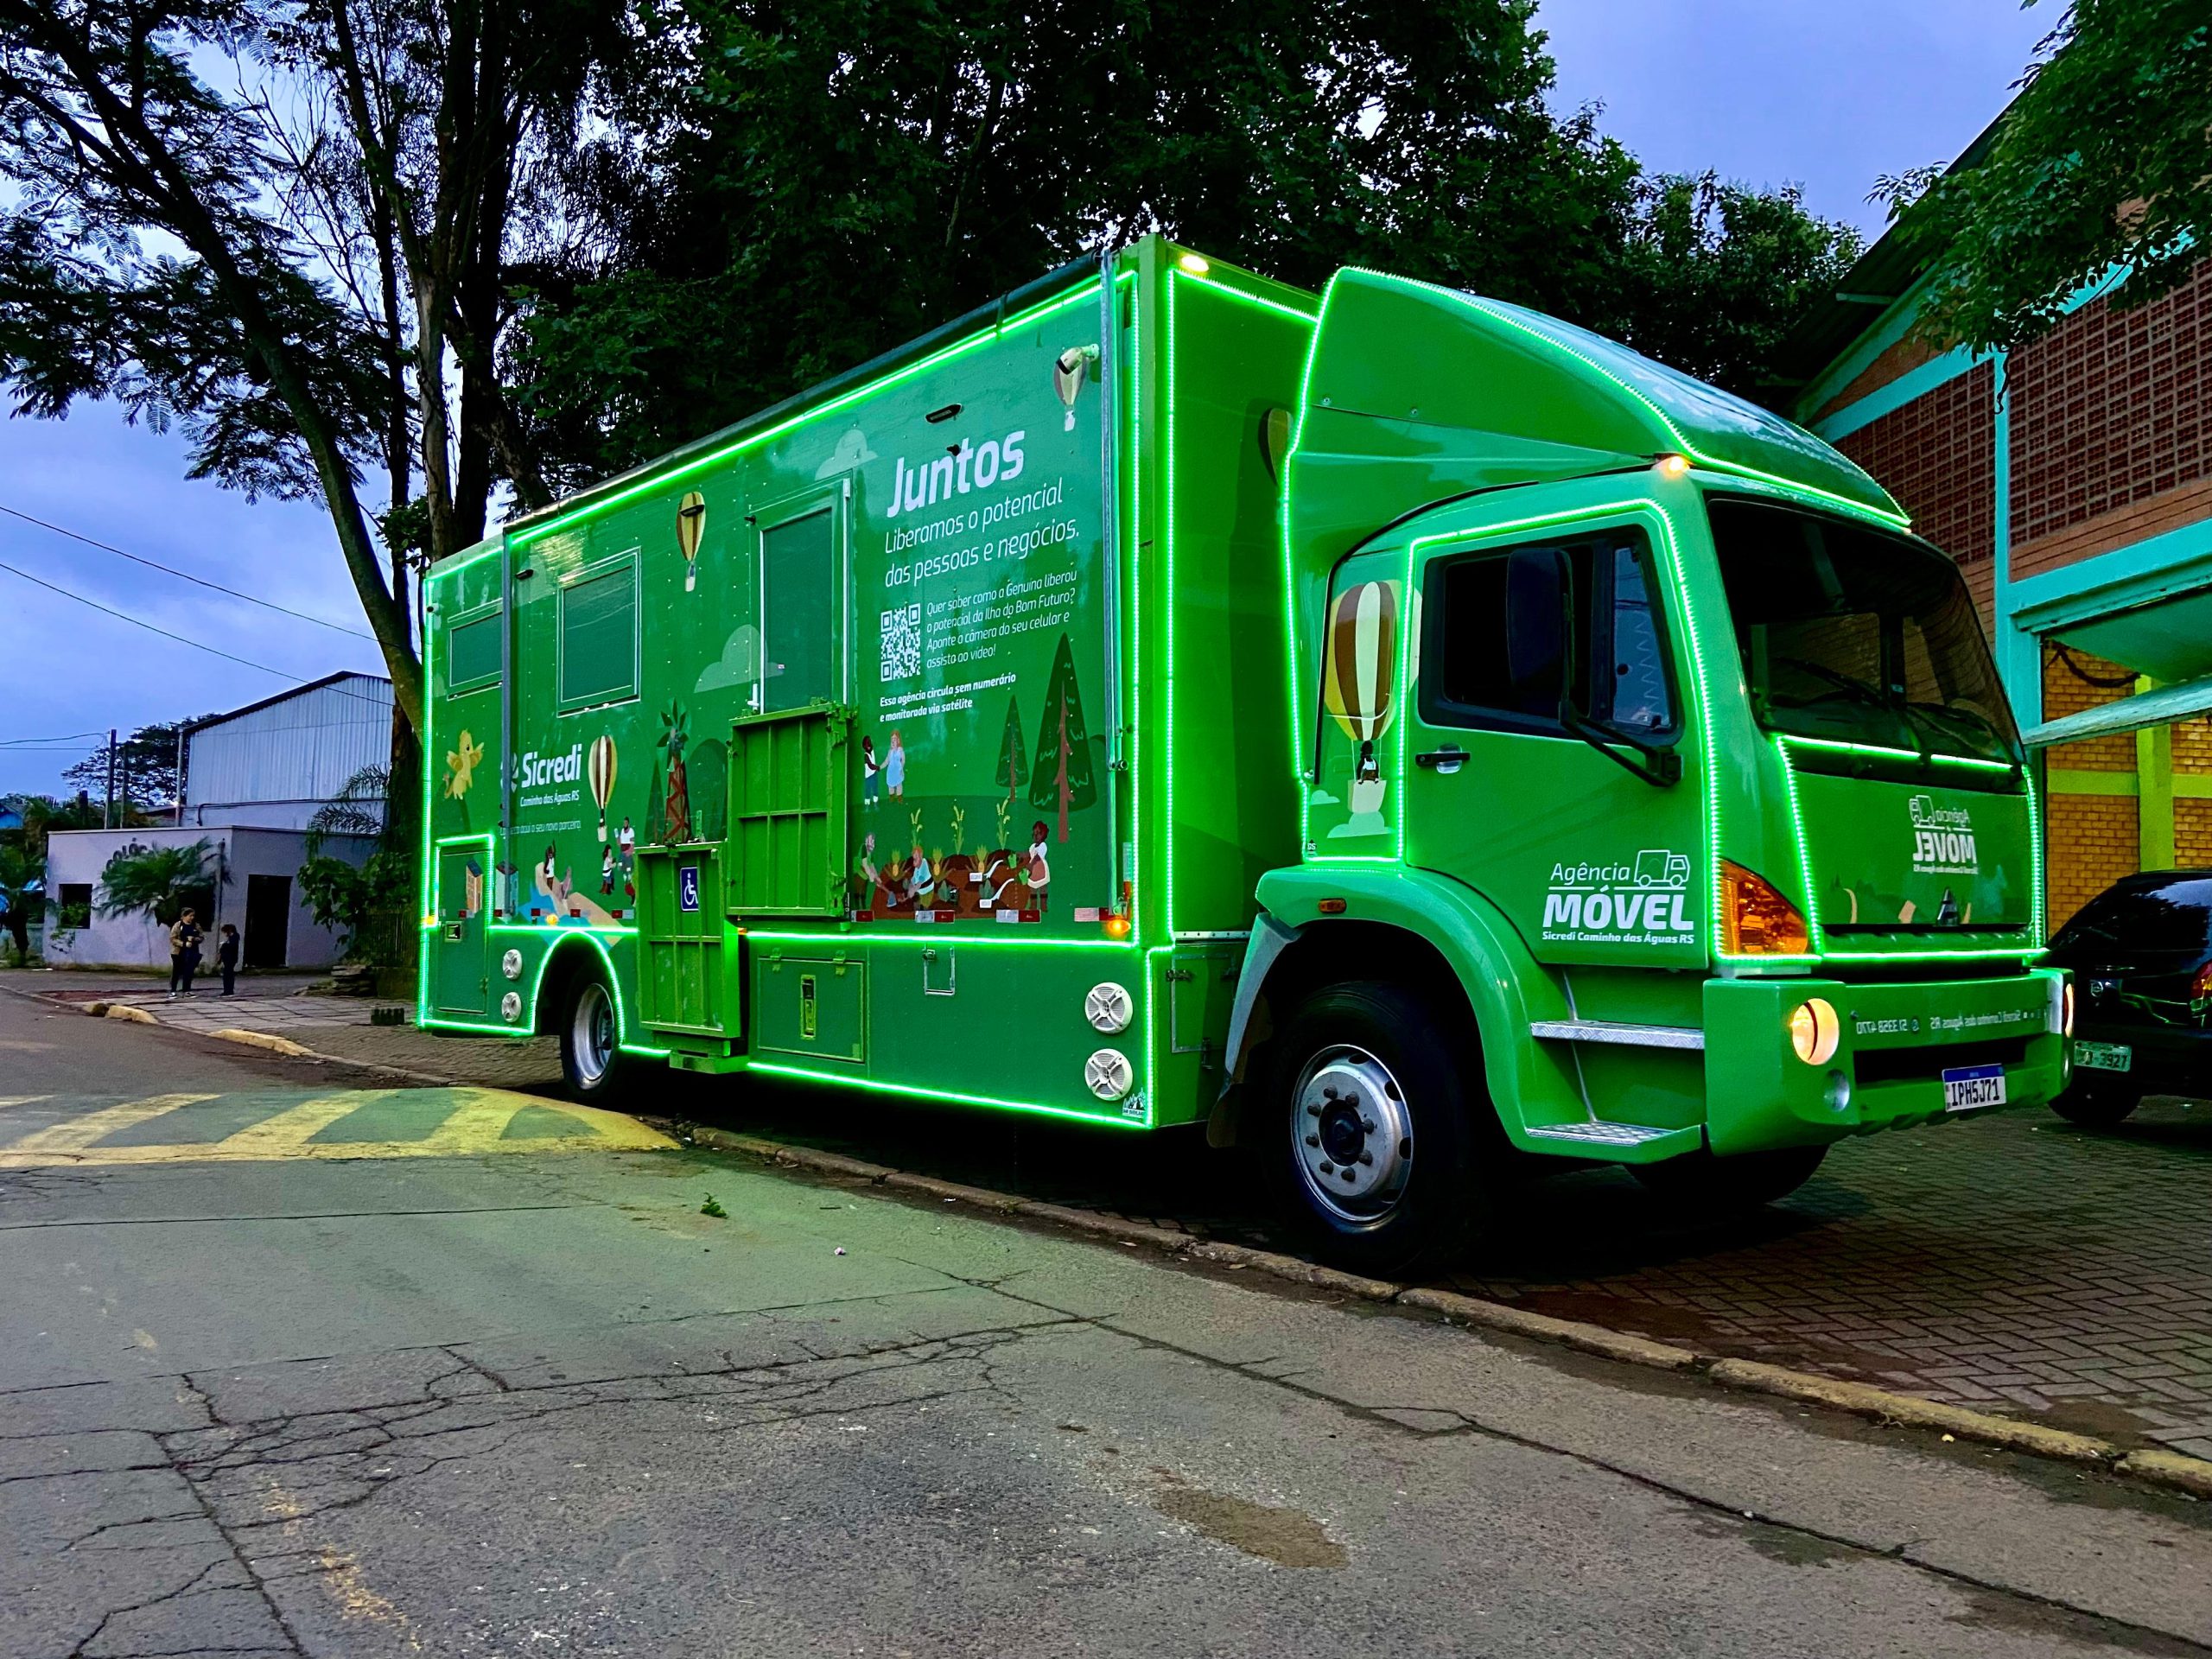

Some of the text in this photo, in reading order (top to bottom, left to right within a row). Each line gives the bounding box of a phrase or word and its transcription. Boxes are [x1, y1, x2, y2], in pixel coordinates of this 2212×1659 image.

[887, 430, 1025, 518] Juntos
[886, 477, 1063, 553] Liberamos o potencial
[886, 518, 1079, 588] das pessoas e negócios.
[926, 602, 946, 617] Quer
[948, 595, 971, 610] saber
[973, 590, 996, 604] como
[998, 588, 1004, 598] a
[1044, 570, 1077, 588] liberou
[926, 588, 1075, 635] o potencial da Ilha do Bom Futuro?
[926, 612, 1070, 652] Aponte a câmera do seu celular e
[926, 654, 956, 669] assista
[957, 652, 968, 663] ao
[880, 672, 1016, 707] Essa agência circula sem numerário
[880, 699, 973, 722] e monitorada via satélite
[521, 743, 582, 788] Sicredi
[543, 793, 553, 804] das
[1550, 862, 1630, 886] Agência
[1542, 885, 1694, 931] MÓVEL
[1542, 931, 1694, 945] Sicredi Caminho das Águas RS
[1952, 1078, 1999, 1106] IPH5J71
